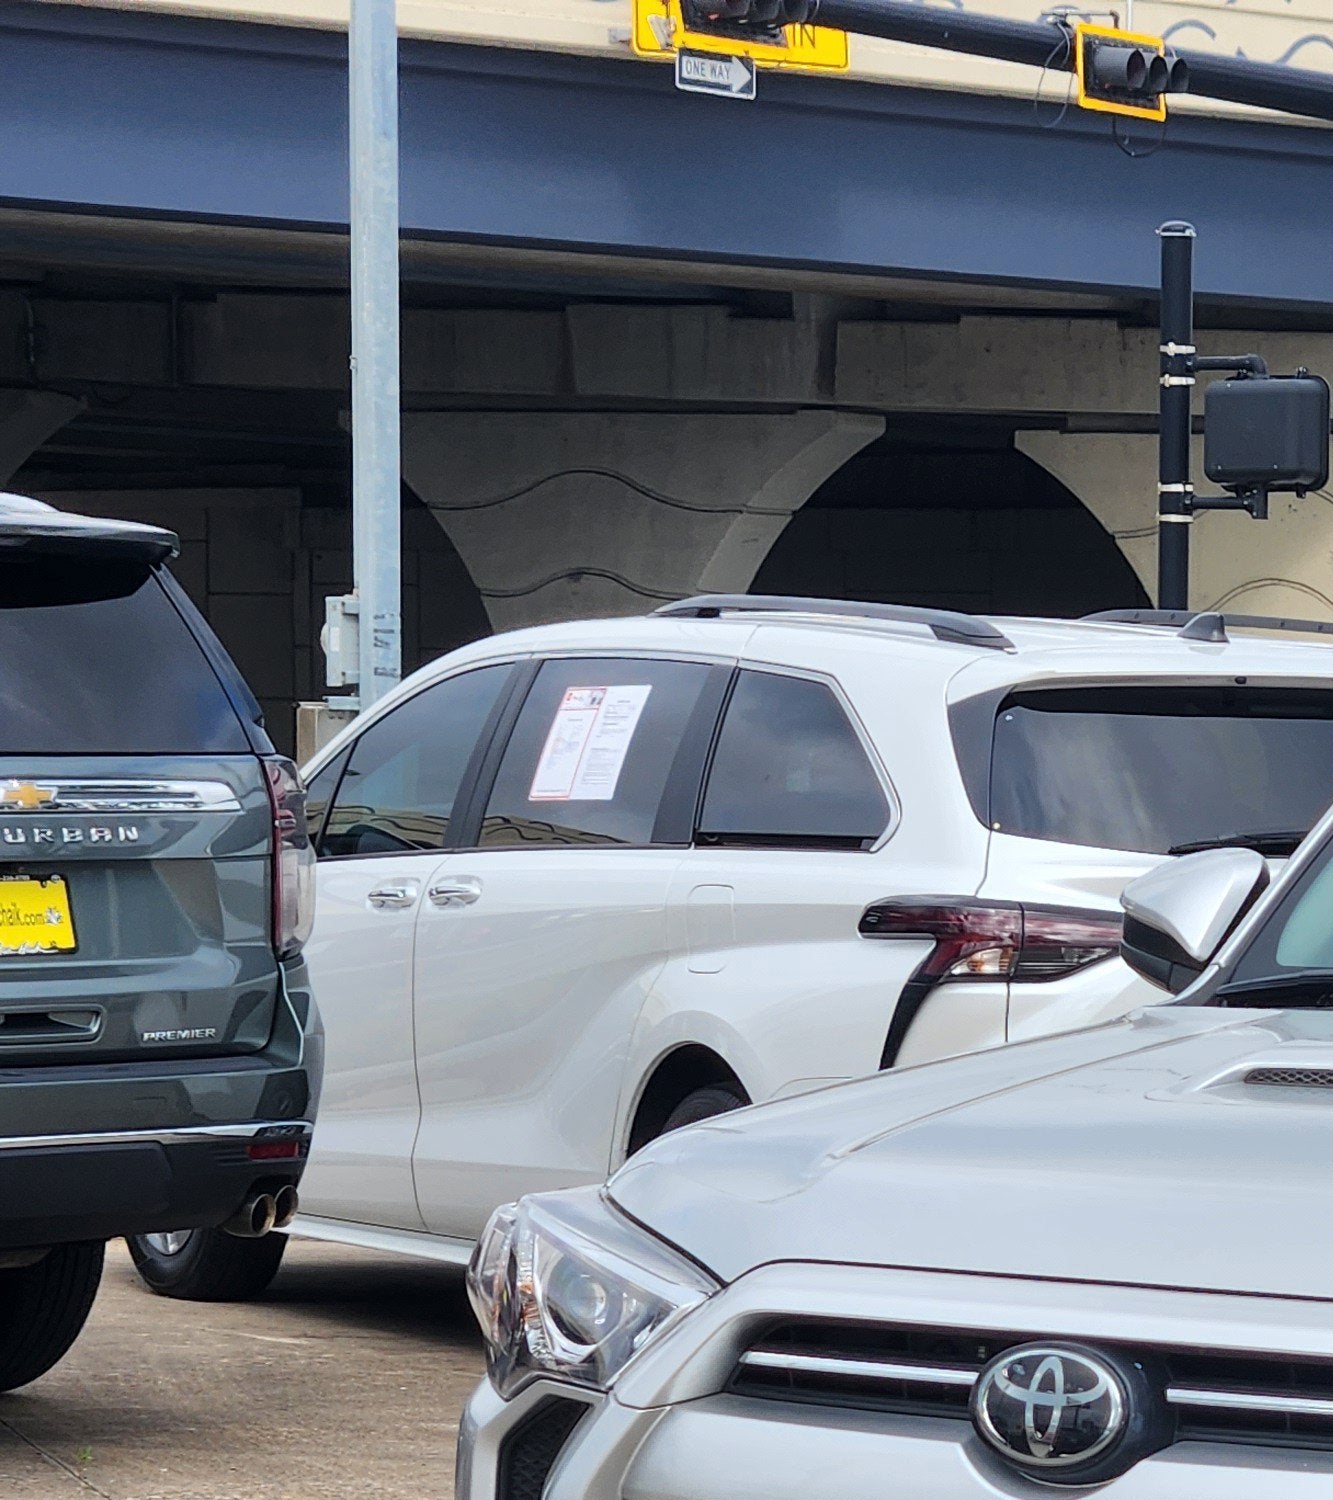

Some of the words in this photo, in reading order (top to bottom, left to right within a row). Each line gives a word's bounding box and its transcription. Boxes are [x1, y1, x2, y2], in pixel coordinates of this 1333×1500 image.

[685, 59, 706, 78] ONE
[709, 63, 731, 80] WAY
[3, 826, 139, 843] URBAN
[142, 1027, 216, 1042] PREMIER
